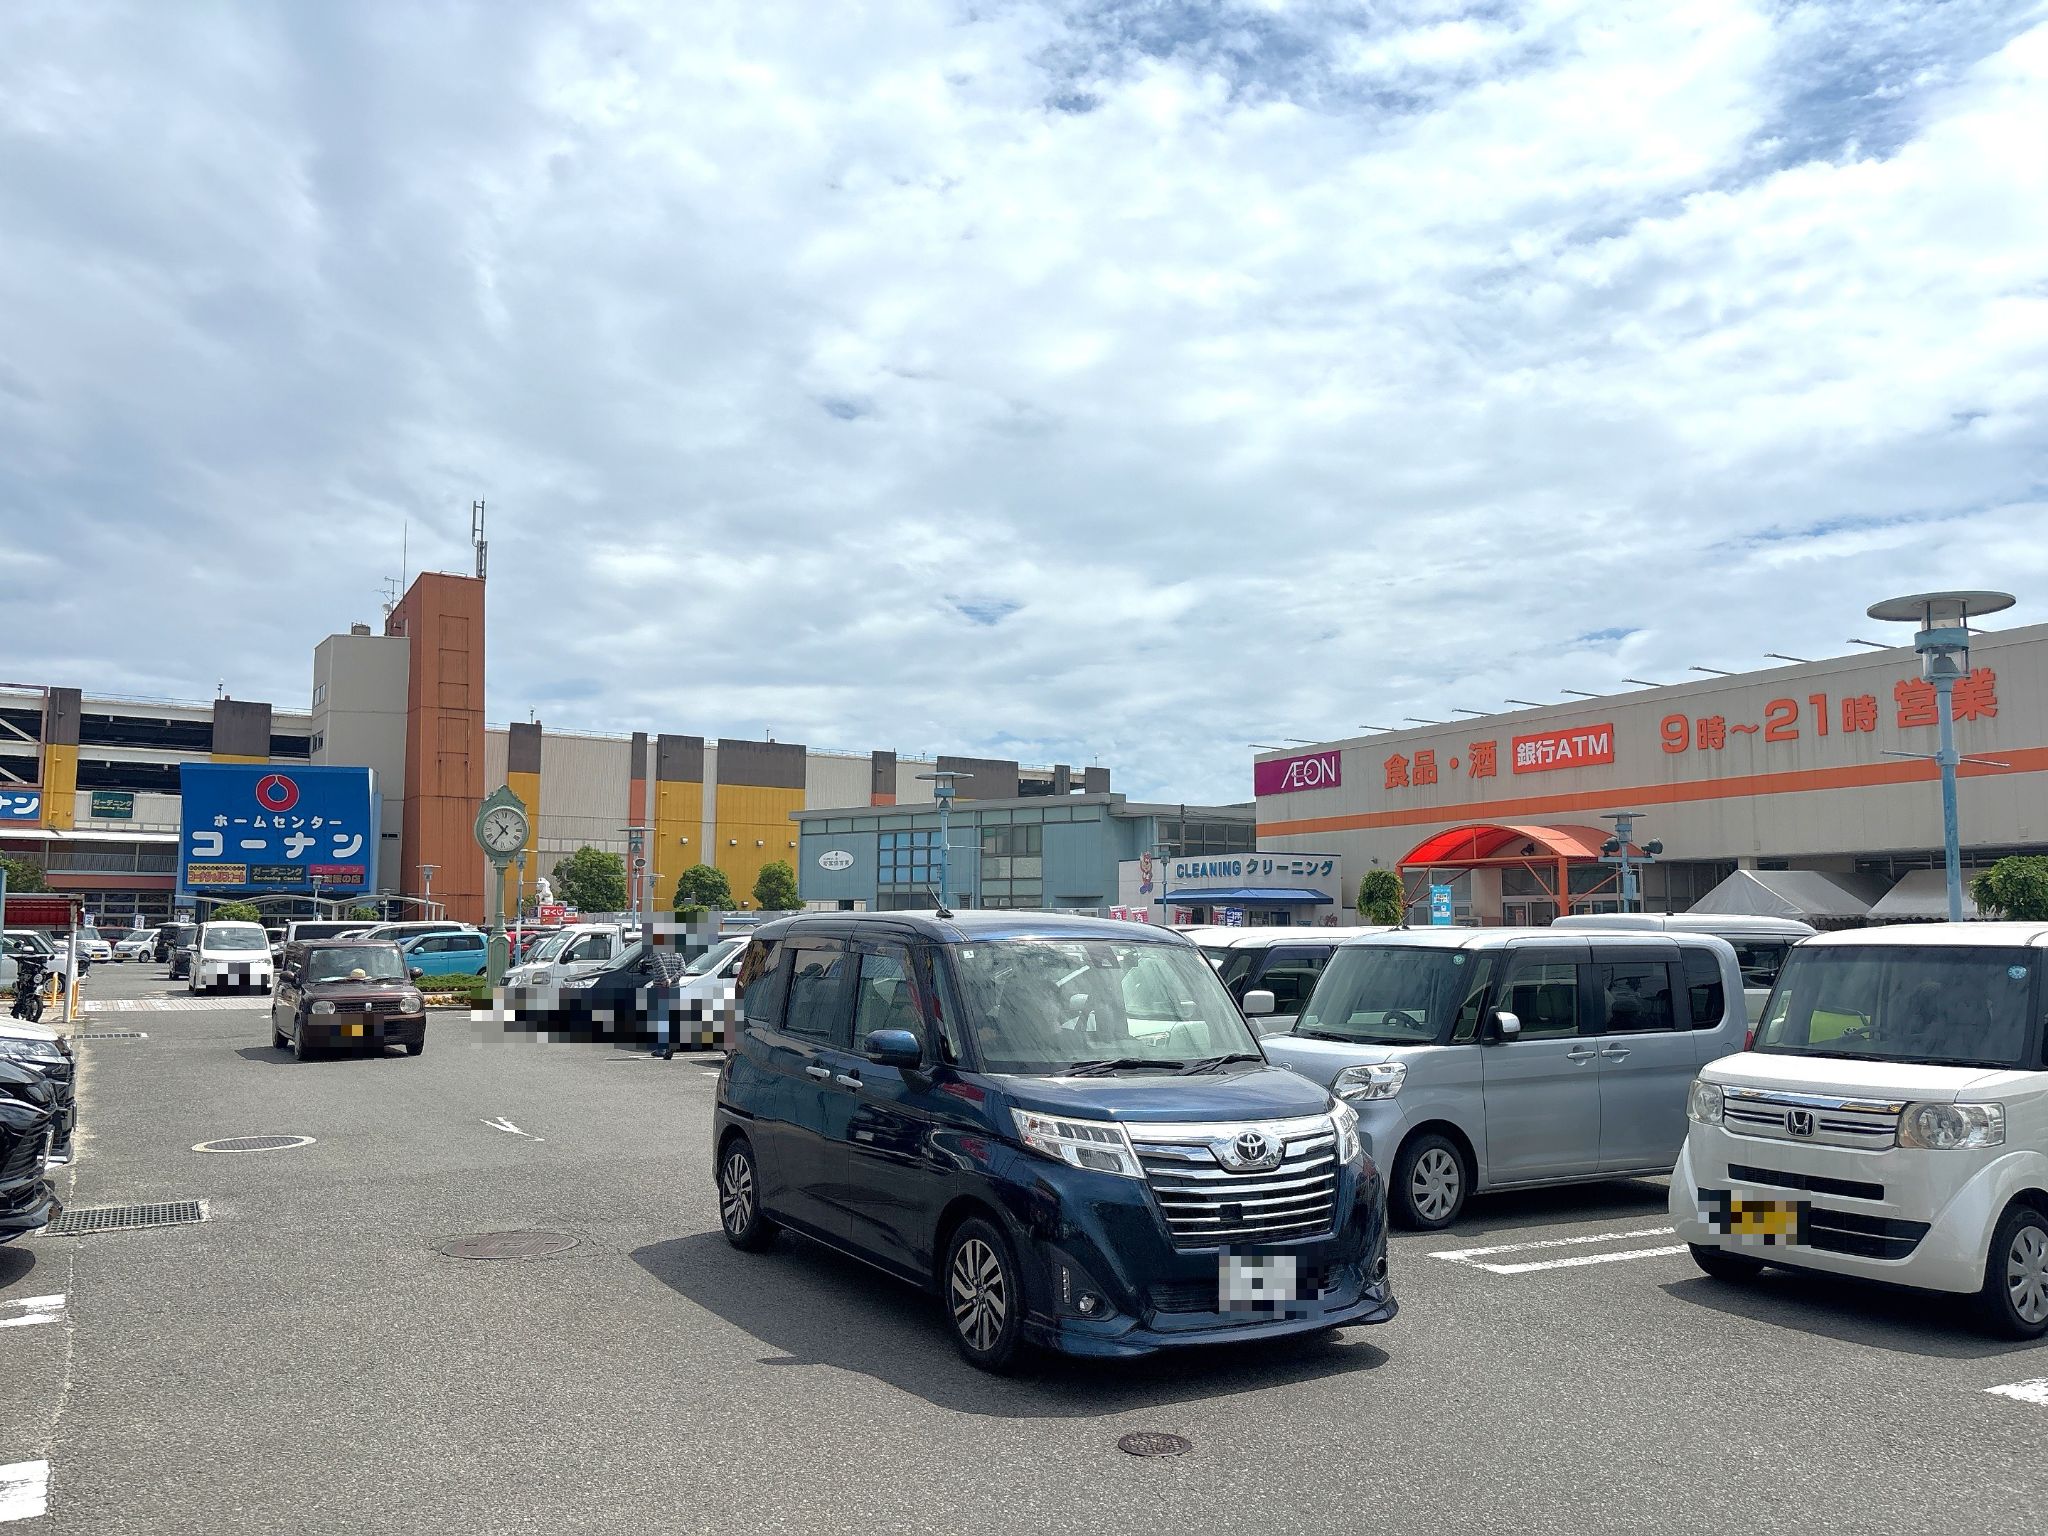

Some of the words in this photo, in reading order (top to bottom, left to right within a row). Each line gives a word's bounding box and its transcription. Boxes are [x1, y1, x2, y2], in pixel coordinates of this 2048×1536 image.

[1516, 731, 1609, 767] 銀行ATM
[1384, 740, 1497, 789] 食品・酒
[214, 814, 342, 829] ホームセンター
[192, 831, 363, 859] コーナン
[252, 866, 304, 876] ガーデニング
[1176, 860, 1242, 879] CLEANING
[1246, 858, 1334, 877] クリーニング
[542, 908, 564, 916] 宝くじ
